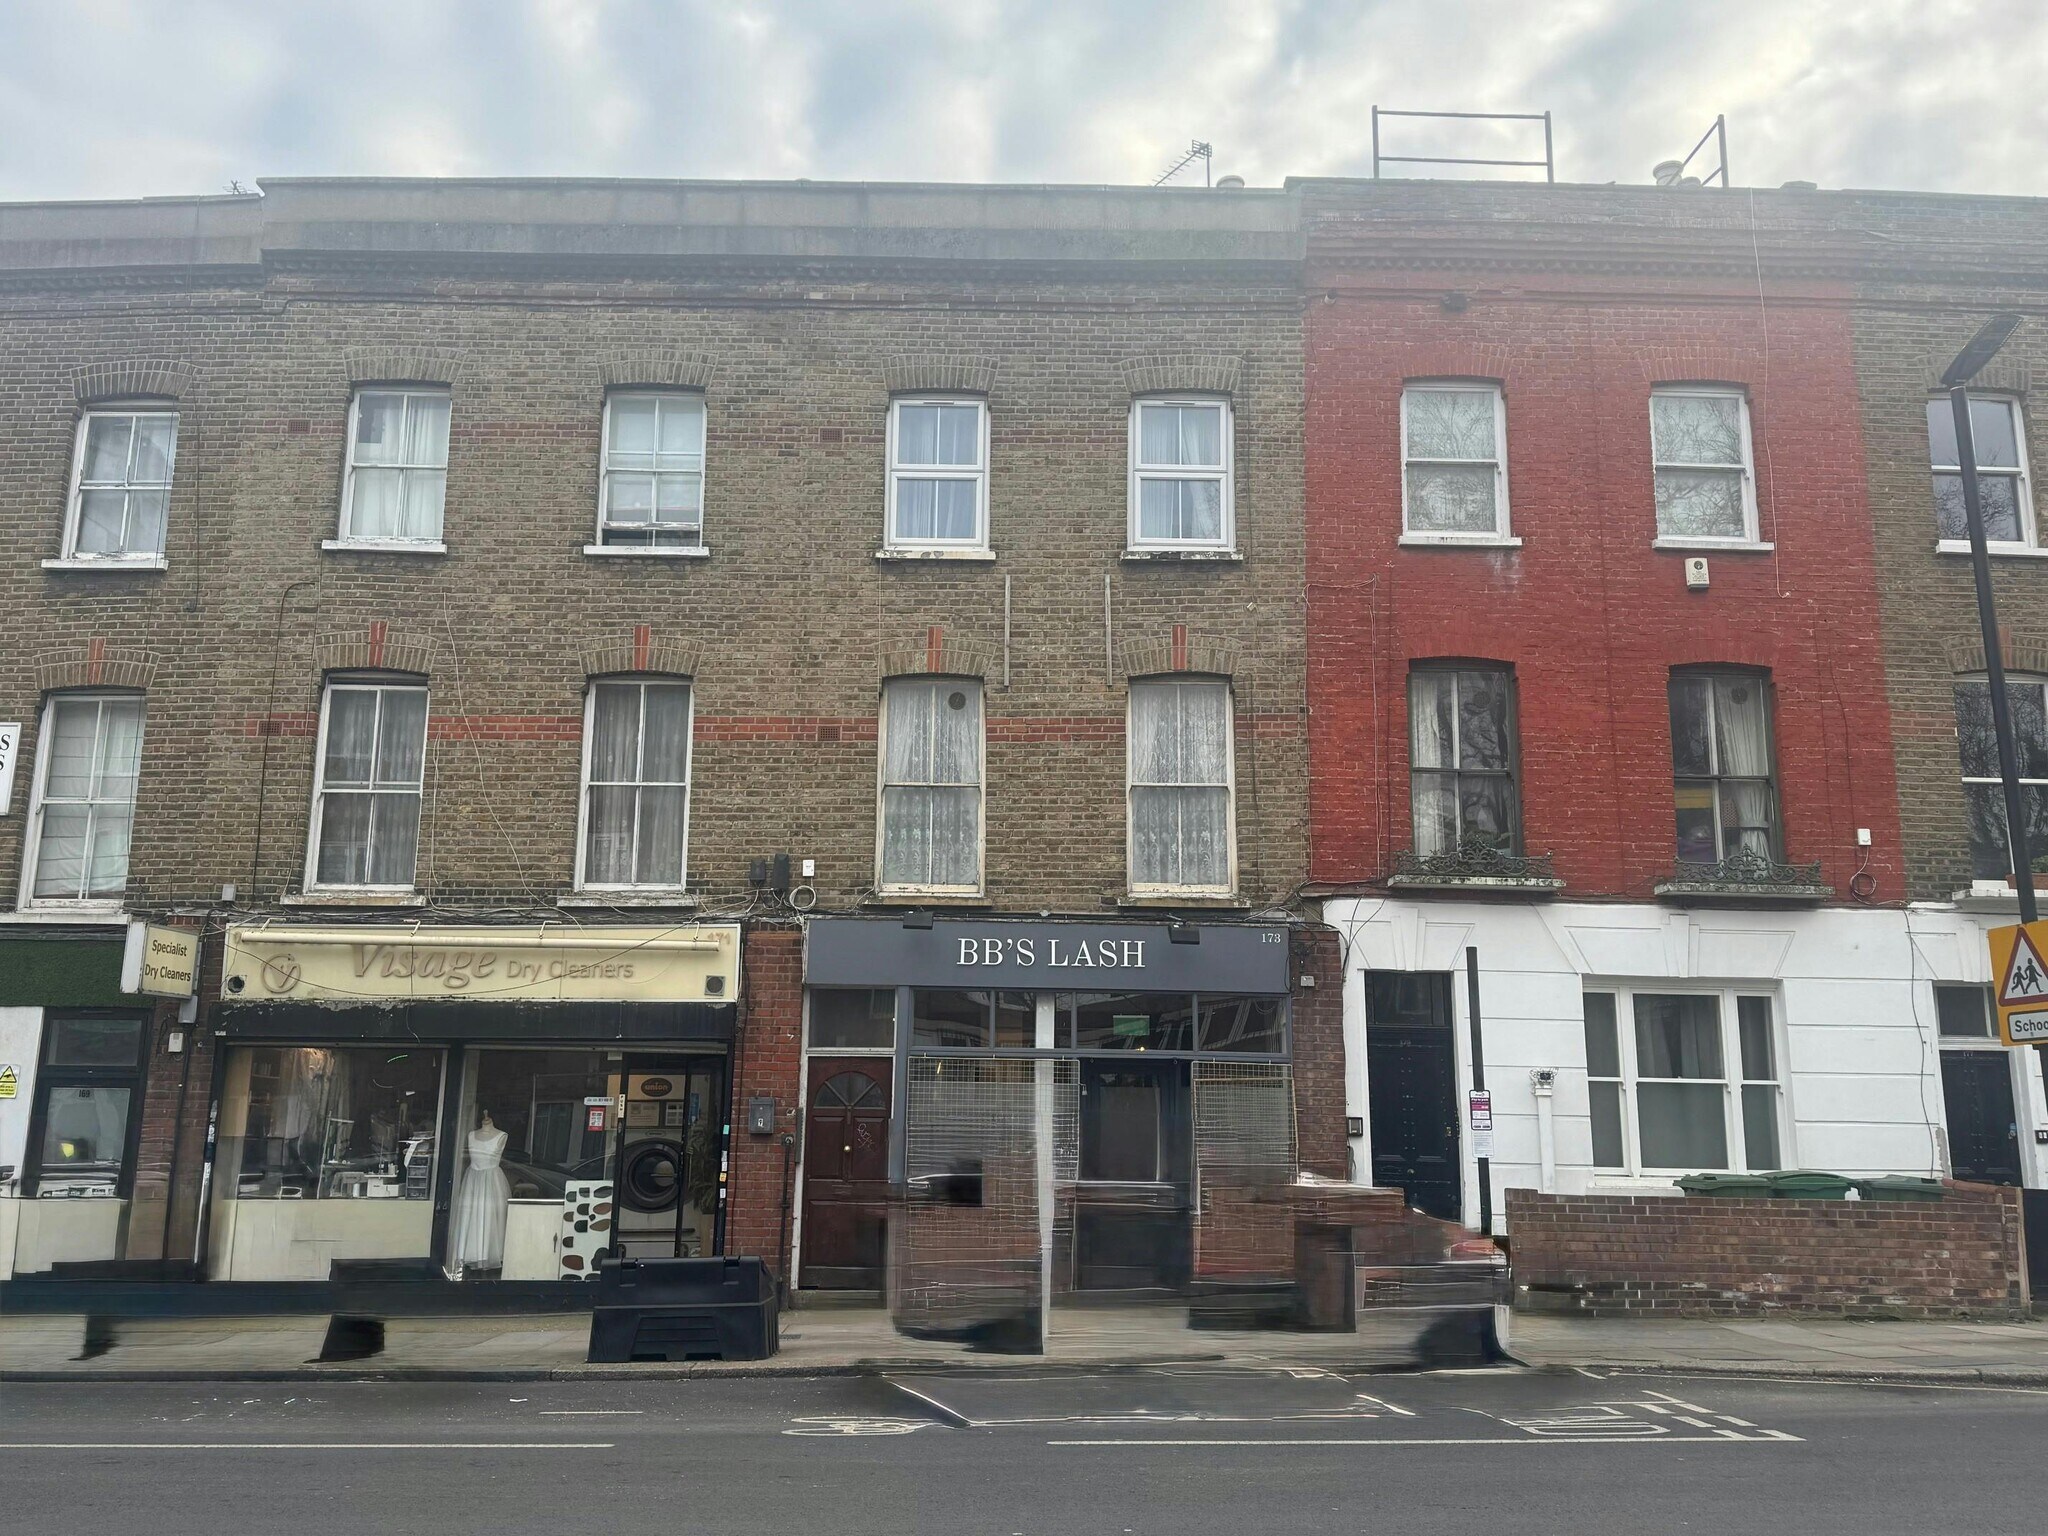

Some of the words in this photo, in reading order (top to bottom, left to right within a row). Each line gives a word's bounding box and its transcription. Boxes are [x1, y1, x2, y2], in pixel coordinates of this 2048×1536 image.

[152, 939, 188, 957] Specialist
[1261, 933, 1281, 944] 173
[1048, 939, 1146, 968] LASH
[145, 963, 159, 980] Dry
[160, 966, 192, 982] Cleaners
[352, 945, 497, 988] Visage
[506, 960, 542, 982] Dry
[549, 960, 634, 978] Cleaners
